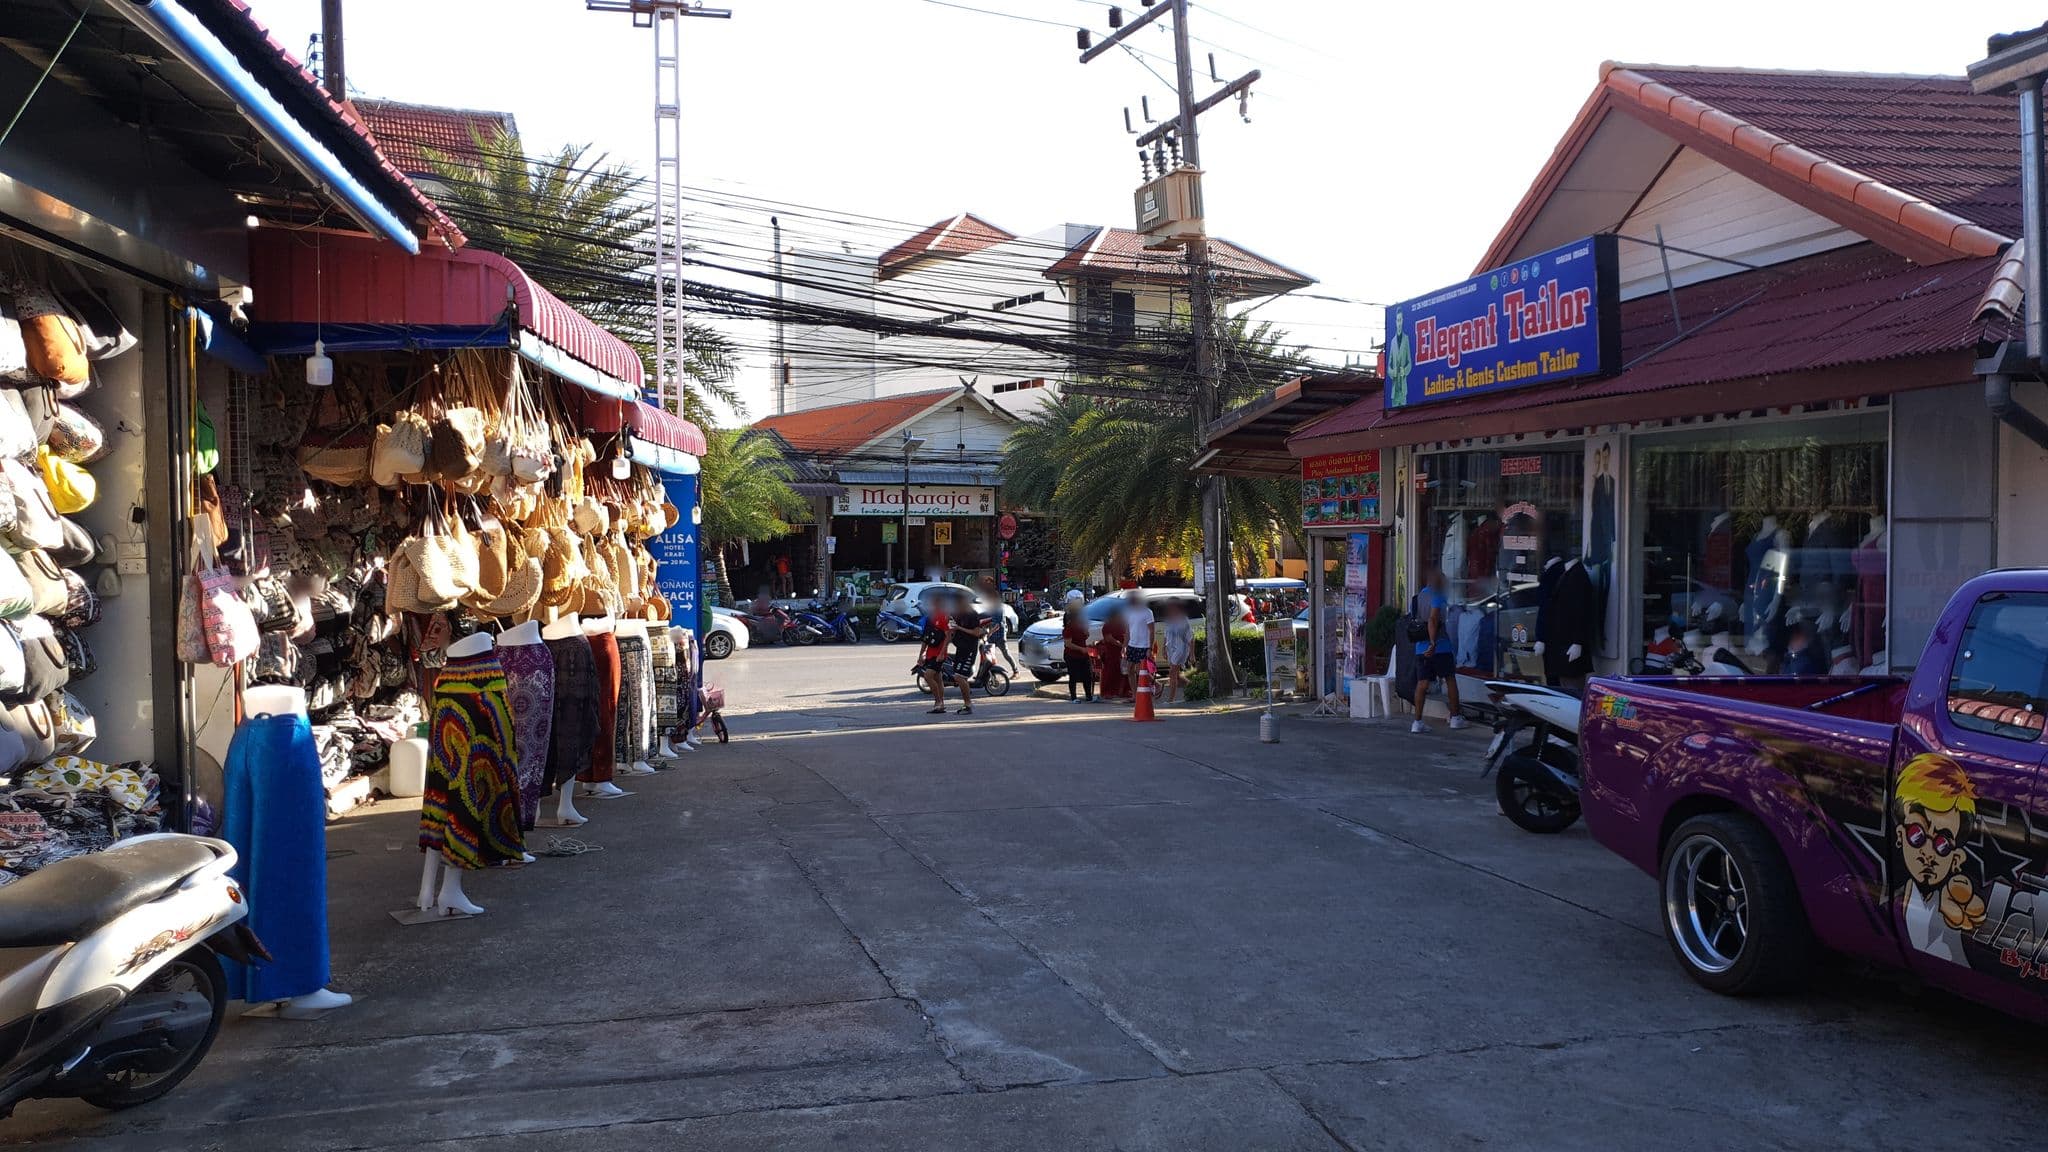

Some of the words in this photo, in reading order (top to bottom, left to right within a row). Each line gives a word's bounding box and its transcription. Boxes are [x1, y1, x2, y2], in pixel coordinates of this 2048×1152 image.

[1415, 303, 1498, 368] Elegant
[1503, 278, 1591, 343] Tailor
[1424, 374, 1456, 396] Ladies
[1456, 369, 1464, 389] &
[1466, 366, 1495, 388] Gents
[1497, 359, 1538, 382] Custom
[1540, 347, 1580, 374] Tailor
[1502, 457, 1541, 474] BESPOKE
[861, 488, 971, 510] Maharaja
[932, 507, 969, 515] Cuisine
[655, 533, 695, 544] ALISA
[663, 591, 694, 601] EACH
